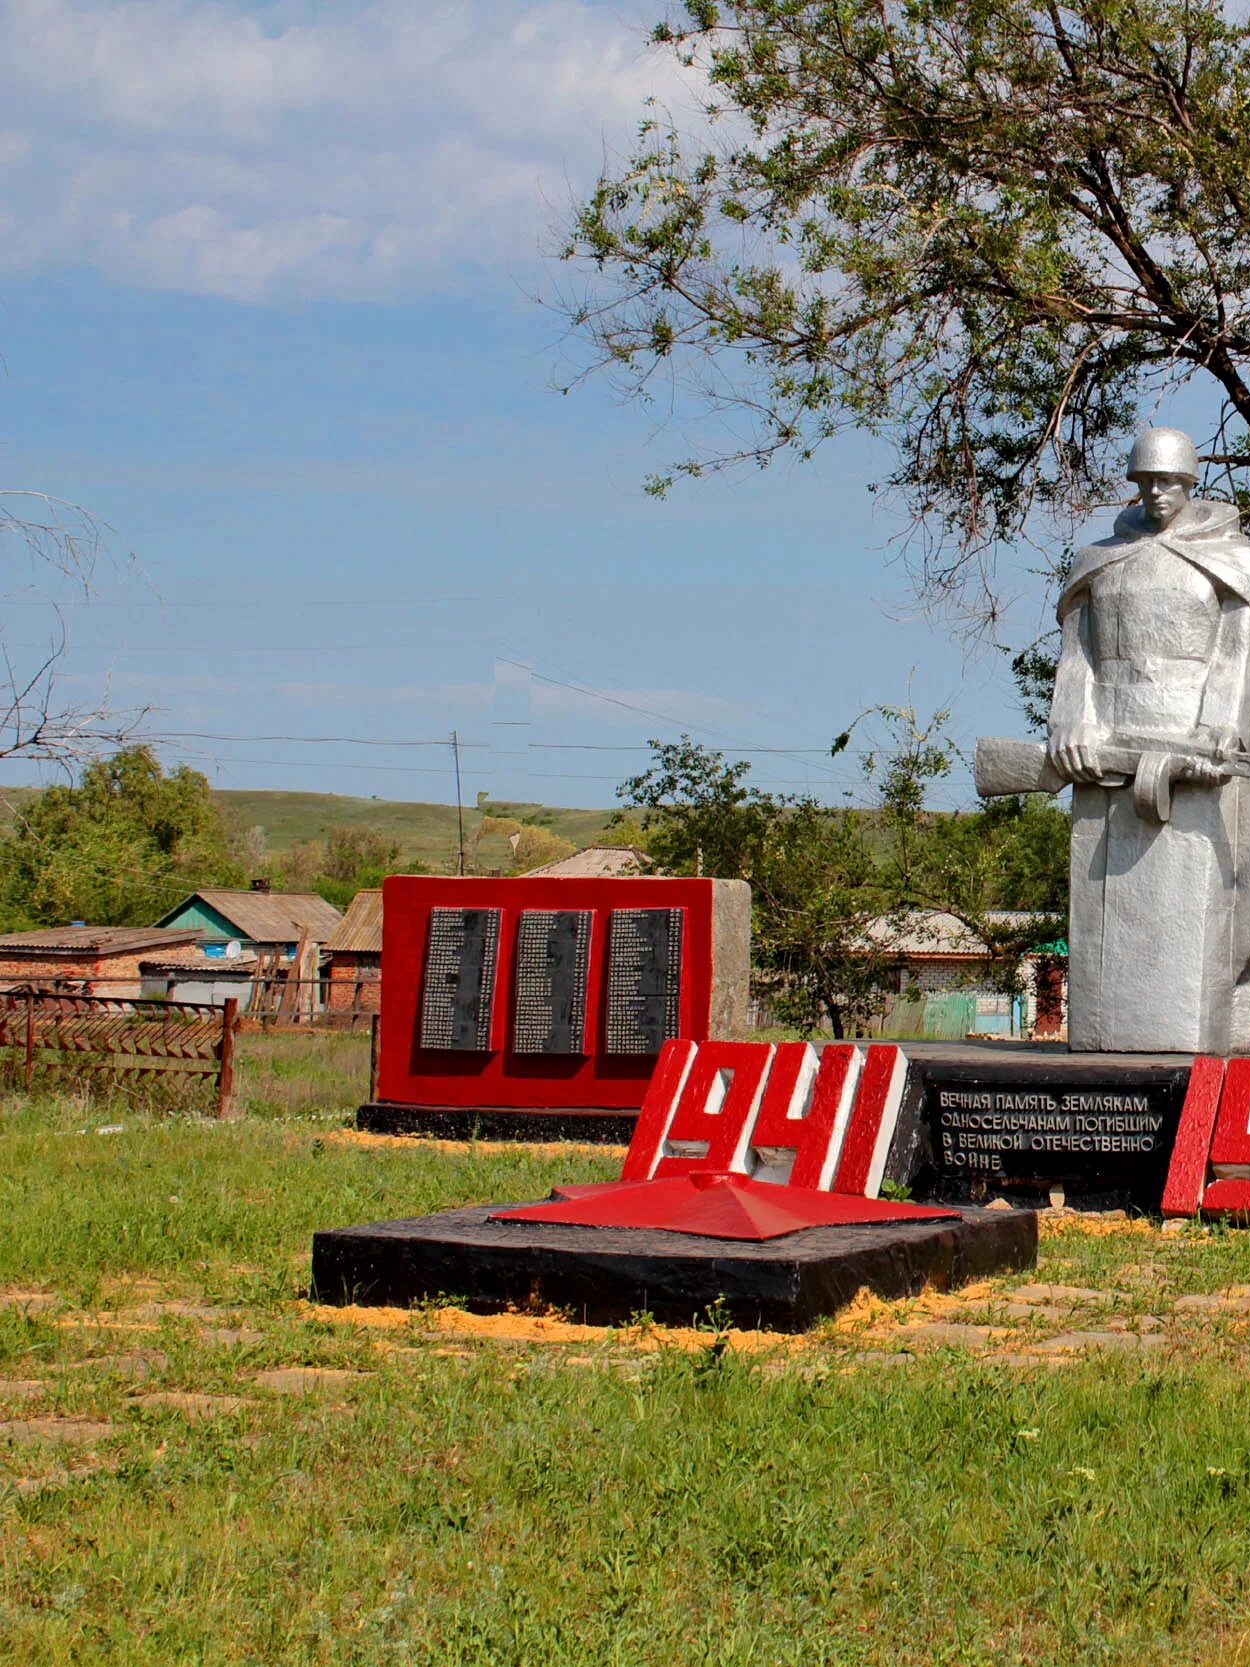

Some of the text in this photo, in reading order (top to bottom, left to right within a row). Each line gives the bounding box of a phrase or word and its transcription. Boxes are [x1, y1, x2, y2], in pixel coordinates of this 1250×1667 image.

[940, 1091, 1148, 1112] ВЕЧНАЯ ПАМЯТЬ ЗЕМЛЯКАМ
[621, 1039, 908, 1199] 1941
[940, 1111, 1163, 1132] ОДНОСЕЛЬЧАНАМ ПОГИБШИМ
[942, 1132, 953, 1148] В
[959, 1132, 1022, 1150] ВЕЛИКОЙ
